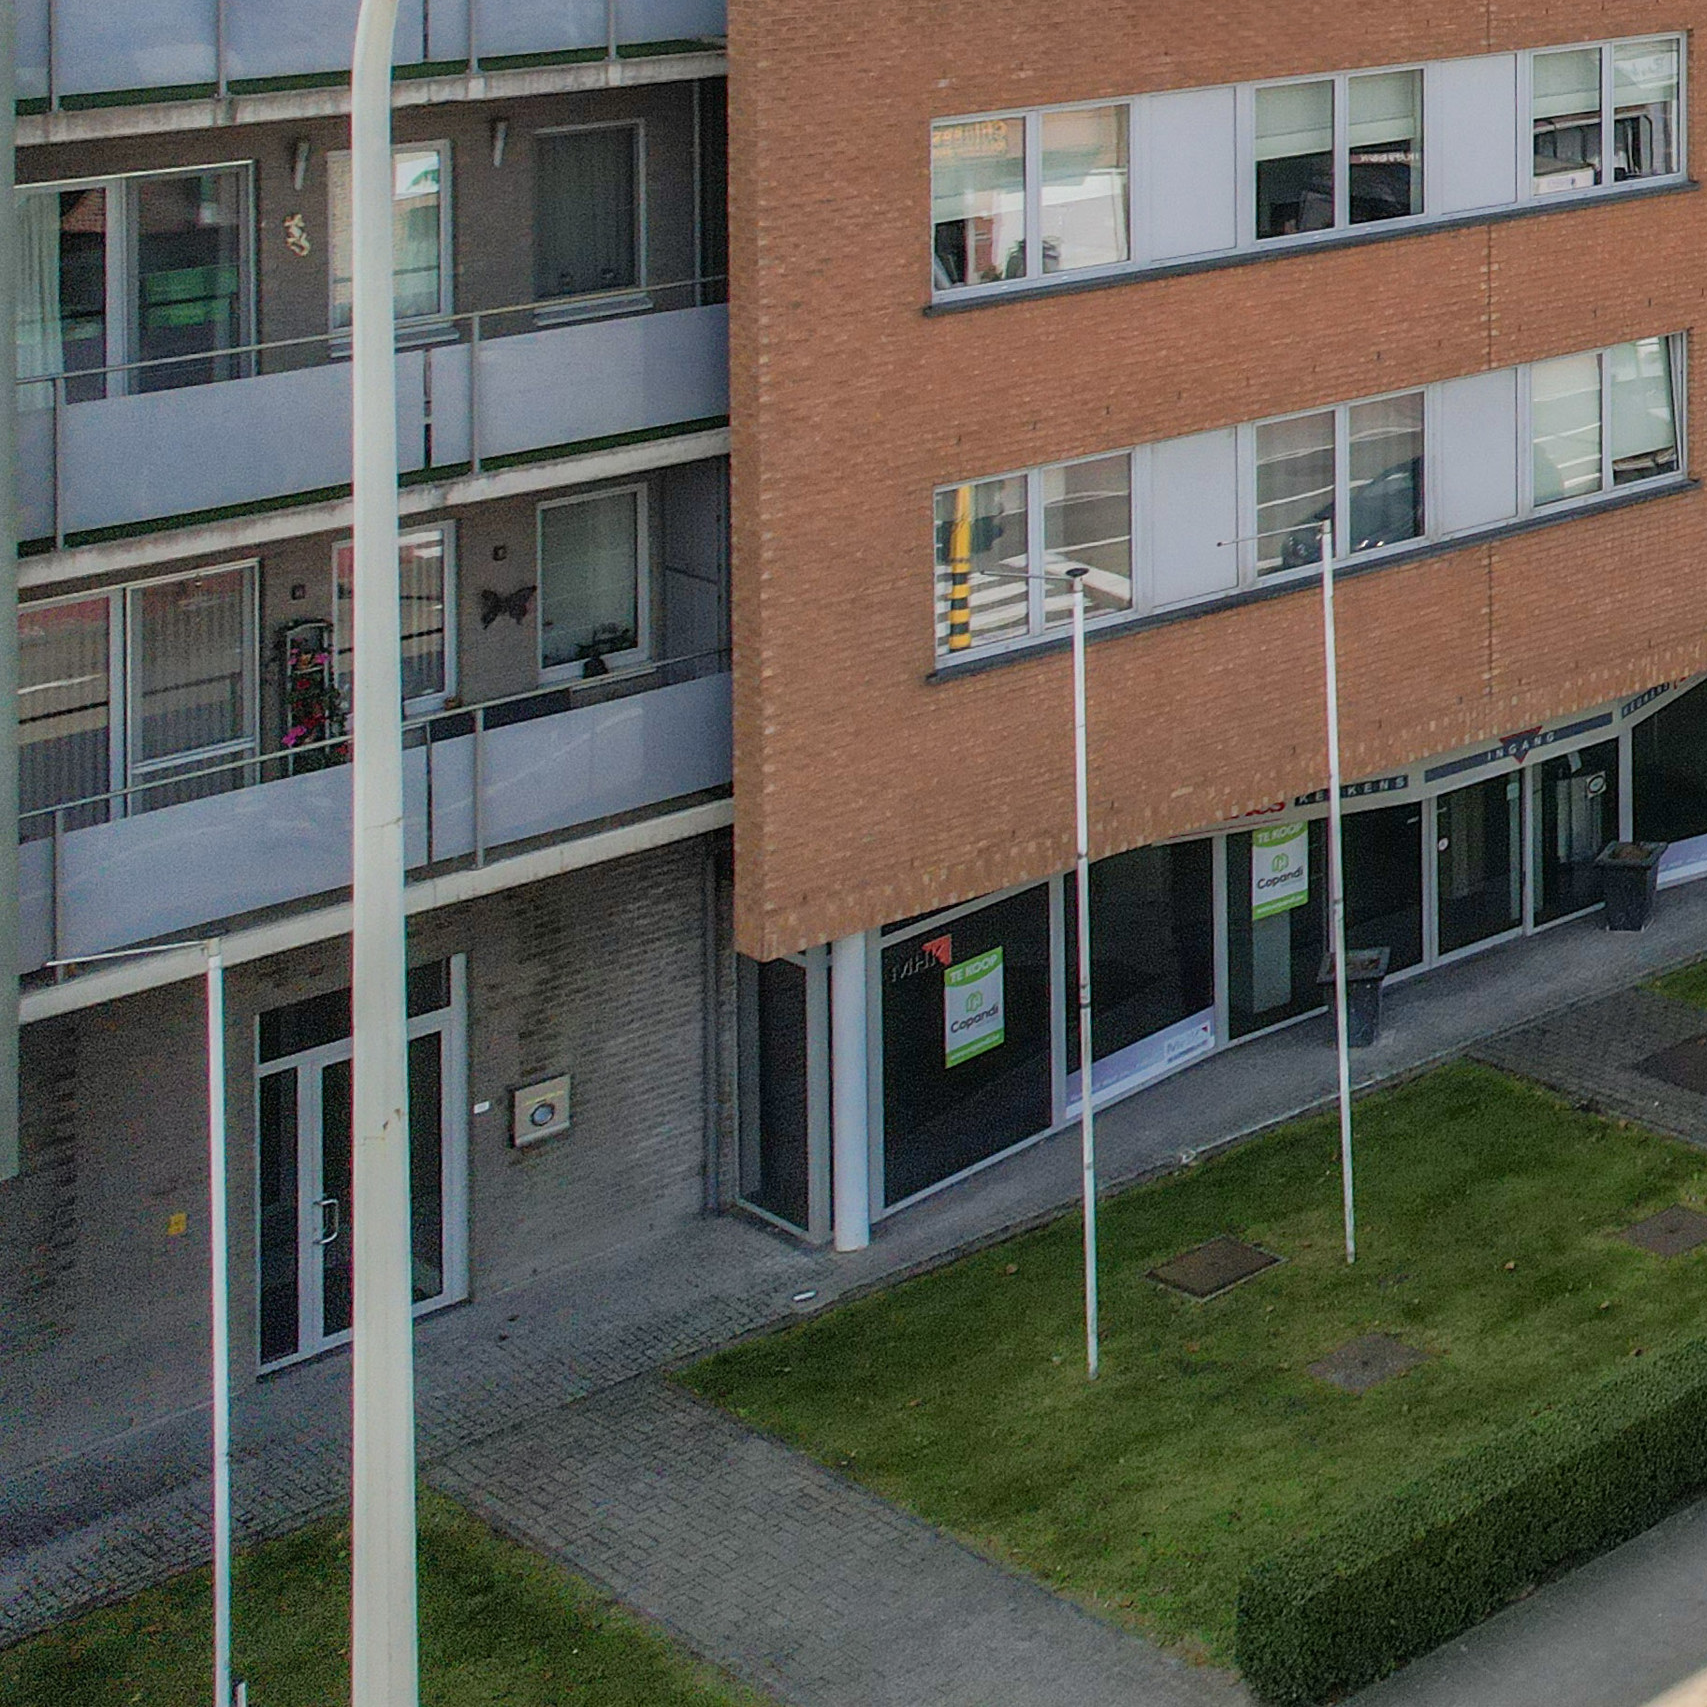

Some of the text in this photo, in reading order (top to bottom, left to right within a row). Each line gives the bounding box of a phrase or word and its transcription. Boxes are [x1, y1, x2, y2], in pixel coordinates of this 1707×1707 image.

[1487, 731, 1555, 761] INGANG
[1298, 776, 1406, 805] KEKENS
[1257, 823, 1303, 844] TE KOOP
[1257, 867, 1304, 890] Copandi
[950, 954, 998, 983] TE KOOP
[950, 1003, 999, 1034] Copandi
